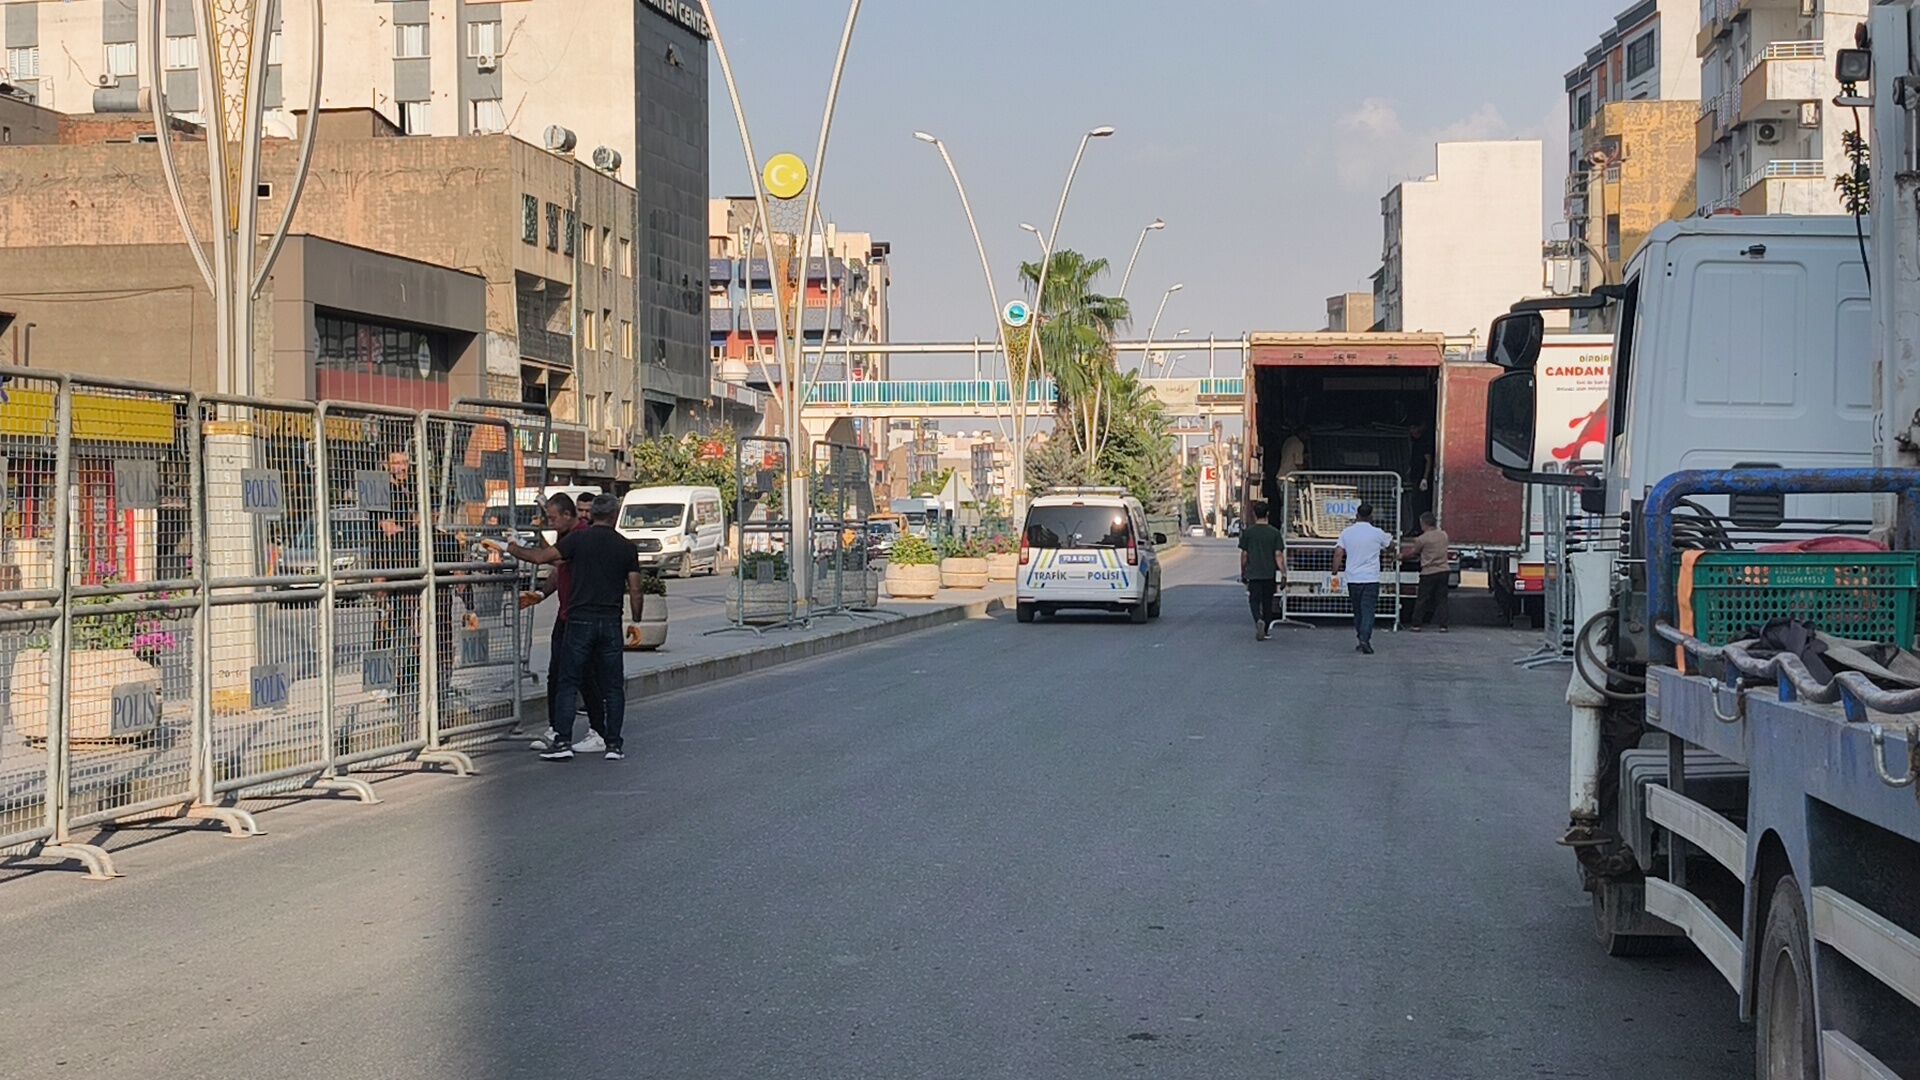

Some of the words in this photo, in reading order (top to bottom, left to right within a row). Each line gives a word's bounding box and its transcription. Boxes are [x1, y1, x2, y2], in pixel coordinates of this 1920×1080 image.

[1545, 367, 1604, 376] CANDAN
[245, 474, 279, 508] POLİS
[1034, 571, 1067, 580] TRAFİK
[1088, 571, 1119, 580] POLİSİ
[254, 666, 286, 706] POLİS
[362, 652, 393, 686] POLİS
[113, 684, 155, 729] POLİS
